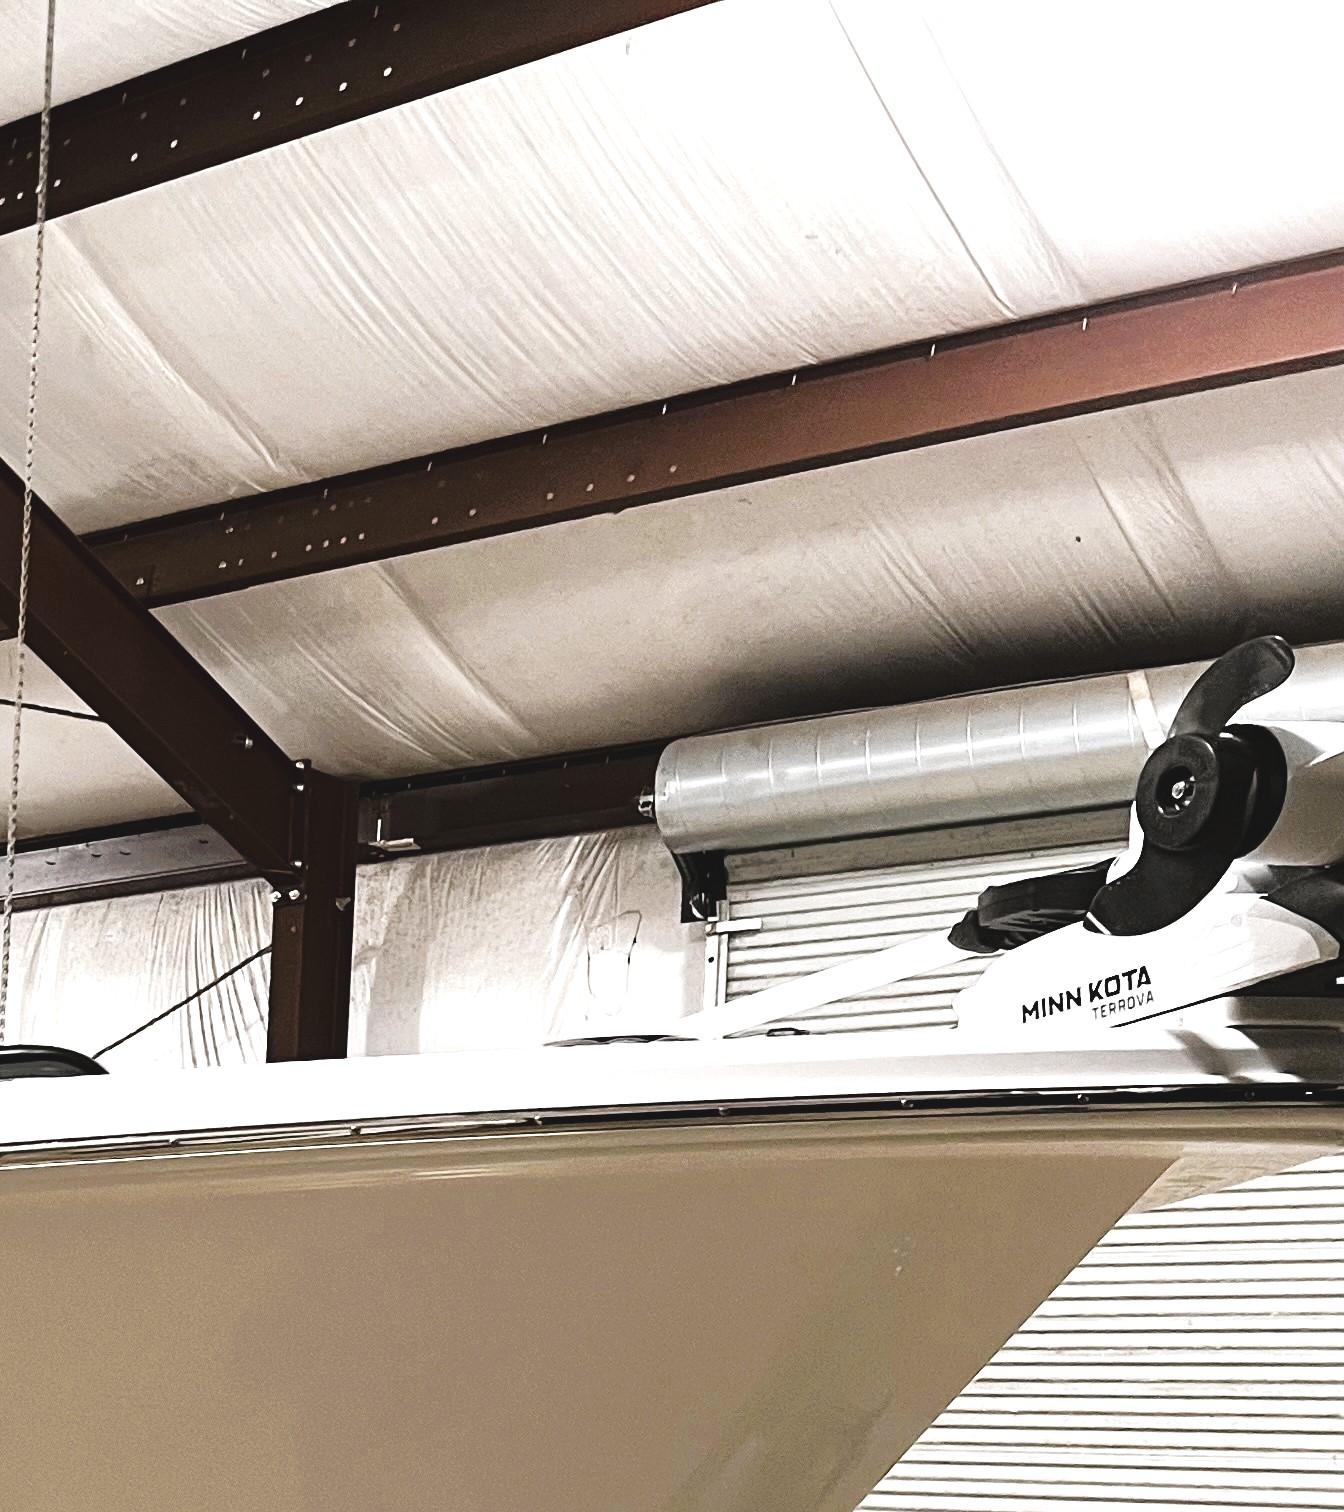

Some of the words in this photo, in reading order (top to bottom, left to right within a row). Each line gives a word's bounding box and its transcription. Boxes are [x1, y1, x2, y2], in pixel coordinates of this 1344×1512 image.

[1021, 986, 1082, 1024] MINN
[1088, 965, 1152, 1003] KOTA
[1091, 990, 1154, 1020] TERROVA
